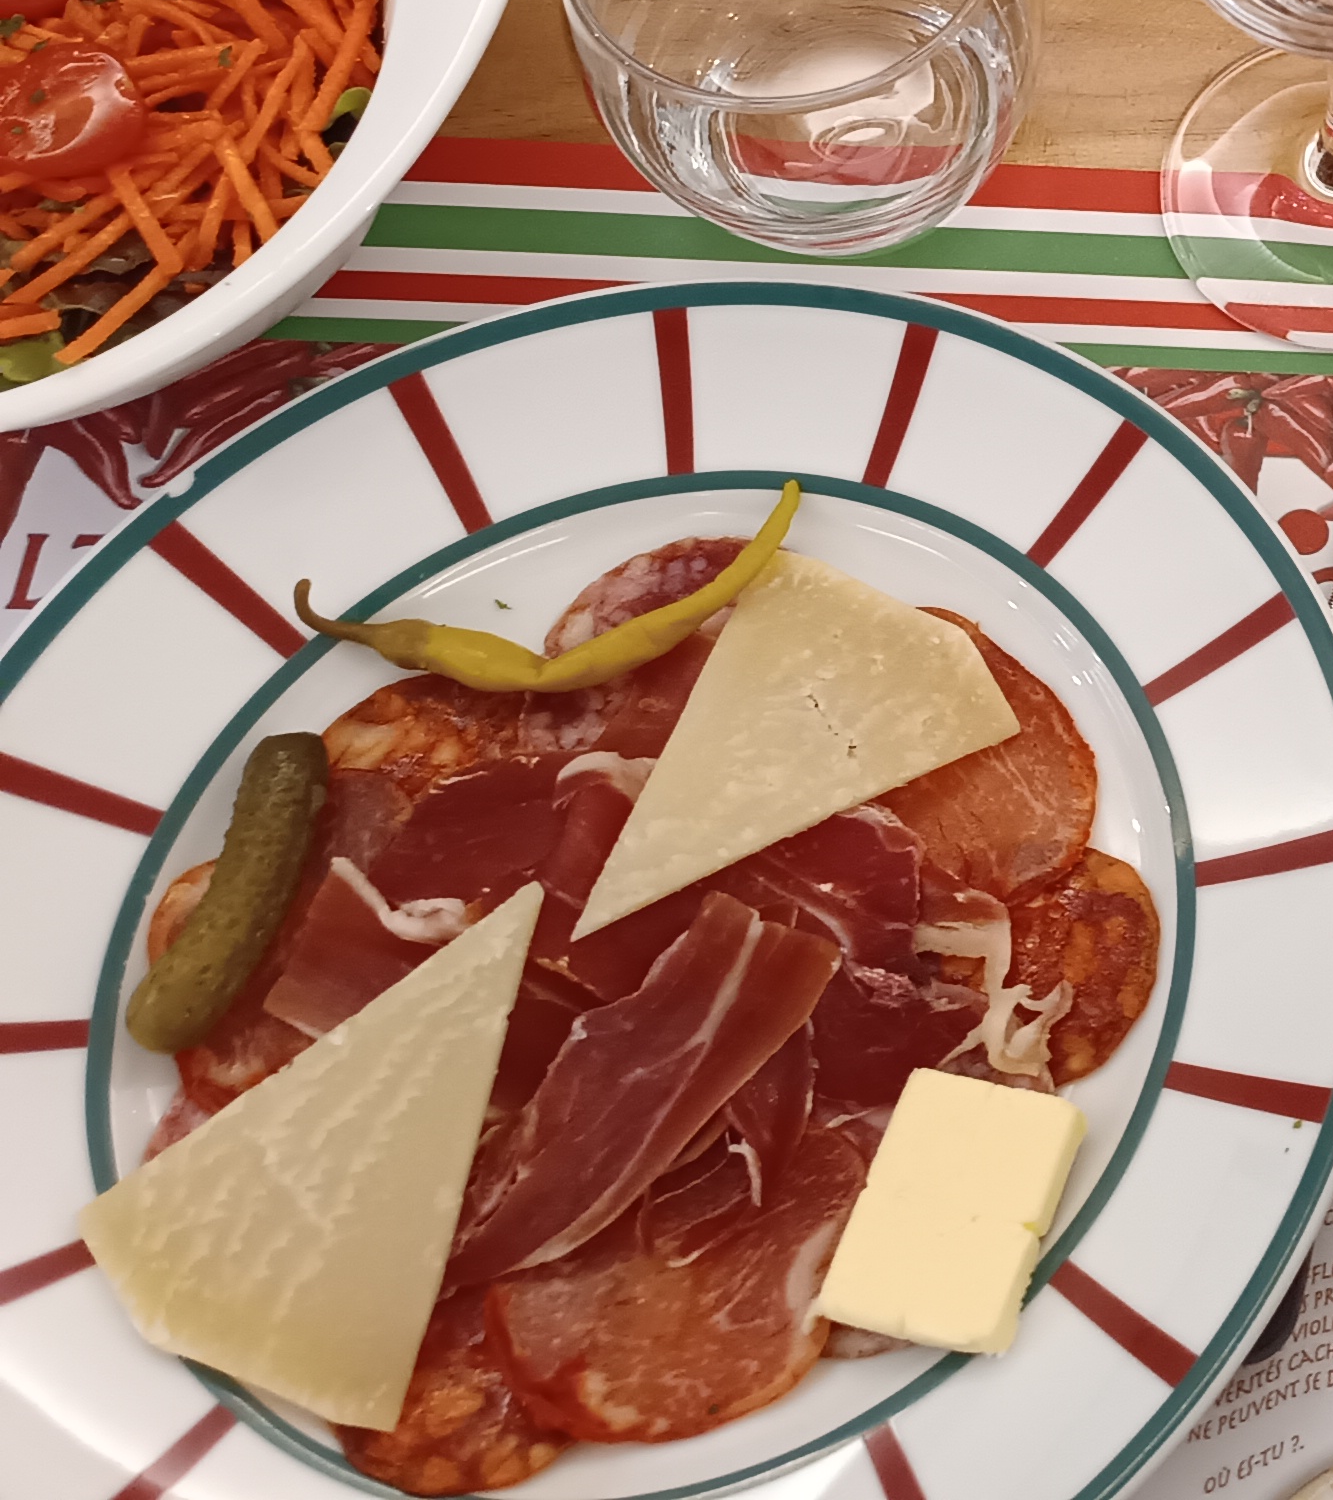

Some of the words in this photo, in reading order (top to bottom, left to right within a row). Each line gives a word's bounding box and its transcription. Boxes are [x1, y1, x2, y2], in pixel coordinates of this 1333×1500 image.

[1216, 1380, 1300, 1435] PEUVENT
[1303, 1371, 1320, 1394] SE
[1203, 1466, 1230, 1494] OÙ
[1237, 1441, 1284, 1481] ES-TU
